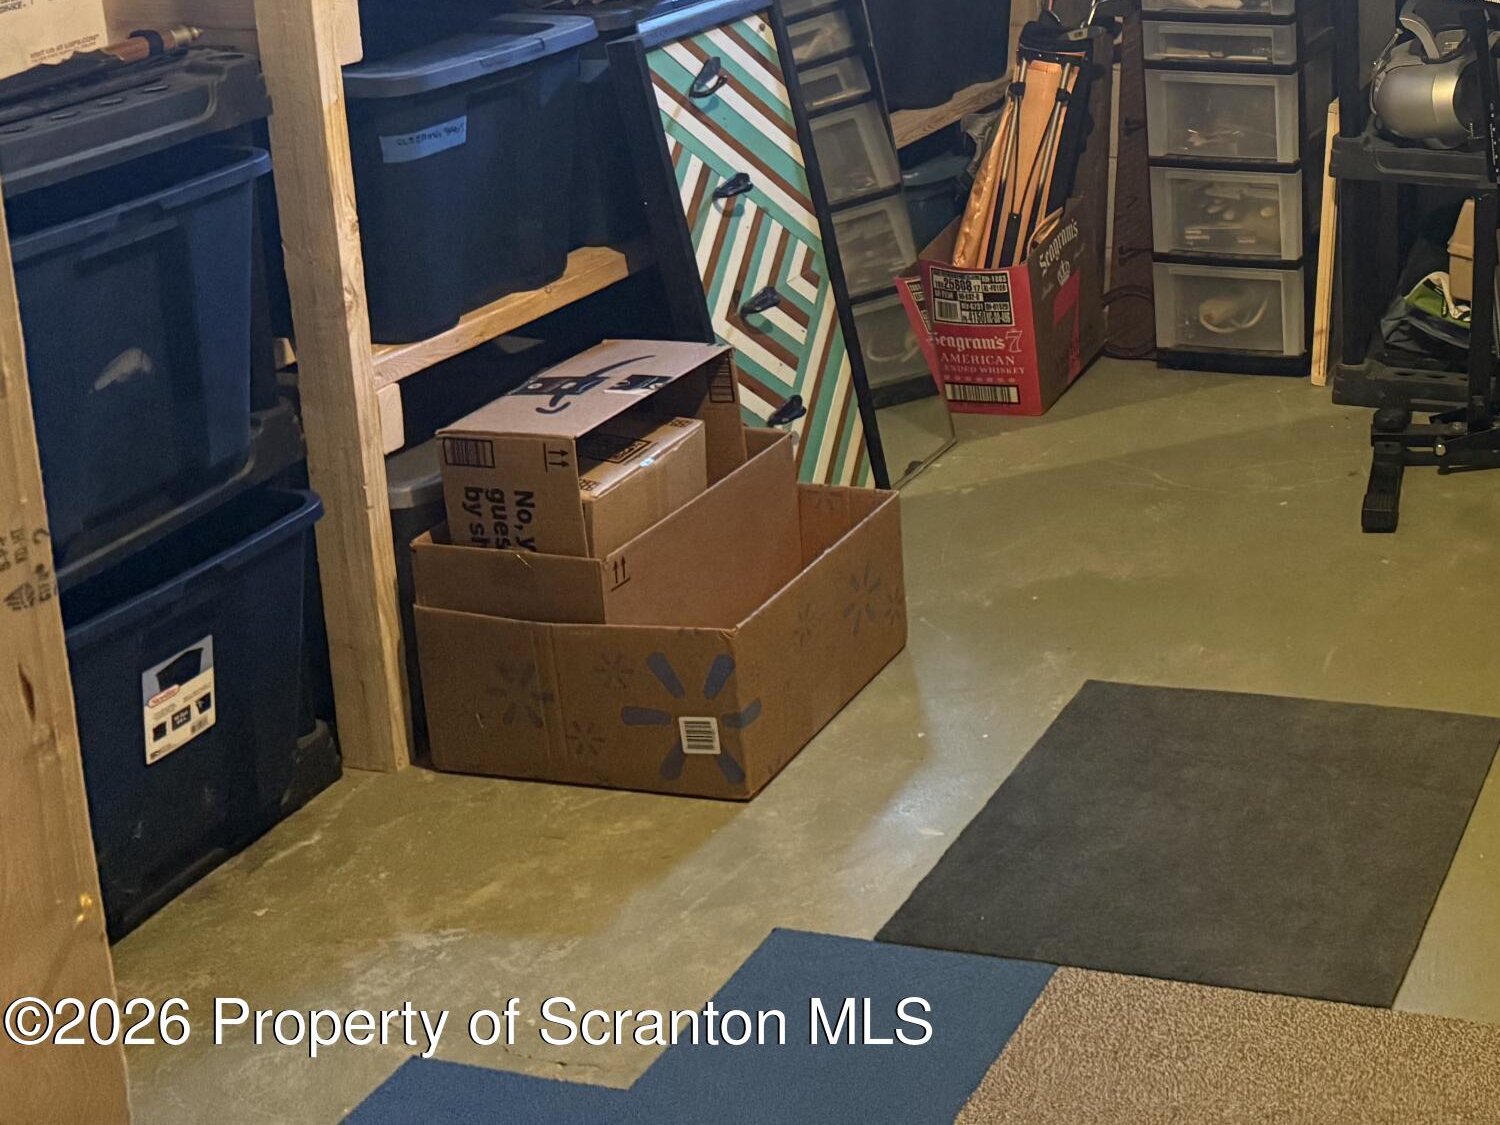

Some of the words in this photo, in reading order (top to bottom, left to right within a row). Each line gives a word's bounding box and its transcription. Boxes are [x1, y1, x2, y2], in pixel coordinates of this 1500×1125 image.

[940, 352, 1015, 366] AMERICAN
[943, 364, 977, 373] ENDED
[979, 365, 1025, 375] WHISKEY
[463, 486, 483, 519] by
[513, 490, 536, 531] No,
